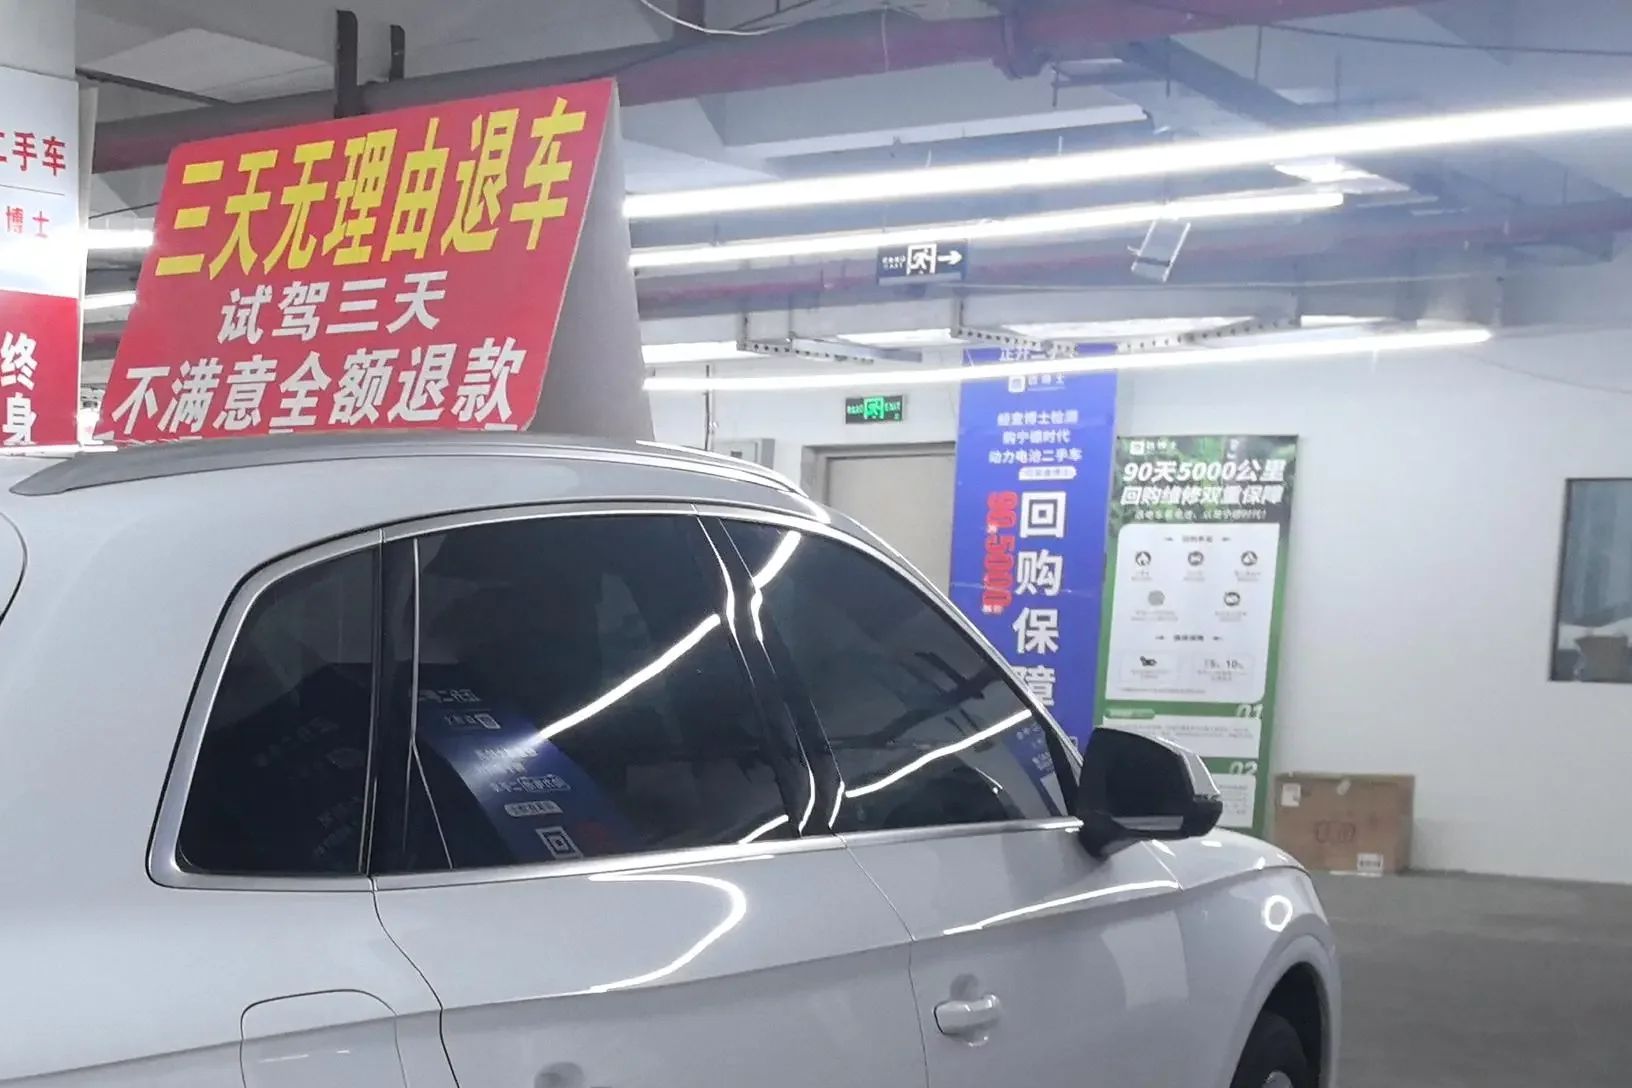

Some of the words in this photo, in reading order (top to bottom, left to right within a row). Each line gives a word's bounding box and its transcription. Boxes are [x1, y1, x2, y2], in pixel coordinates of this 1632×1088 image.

[155, 98, 585, 280] 三天无理由退车
[218, 271, 447, 345] 试驾三天
[112, 337, 527, 434] 不满意全额退款
[1123, 459, 1286, 482] 90天5000公里
